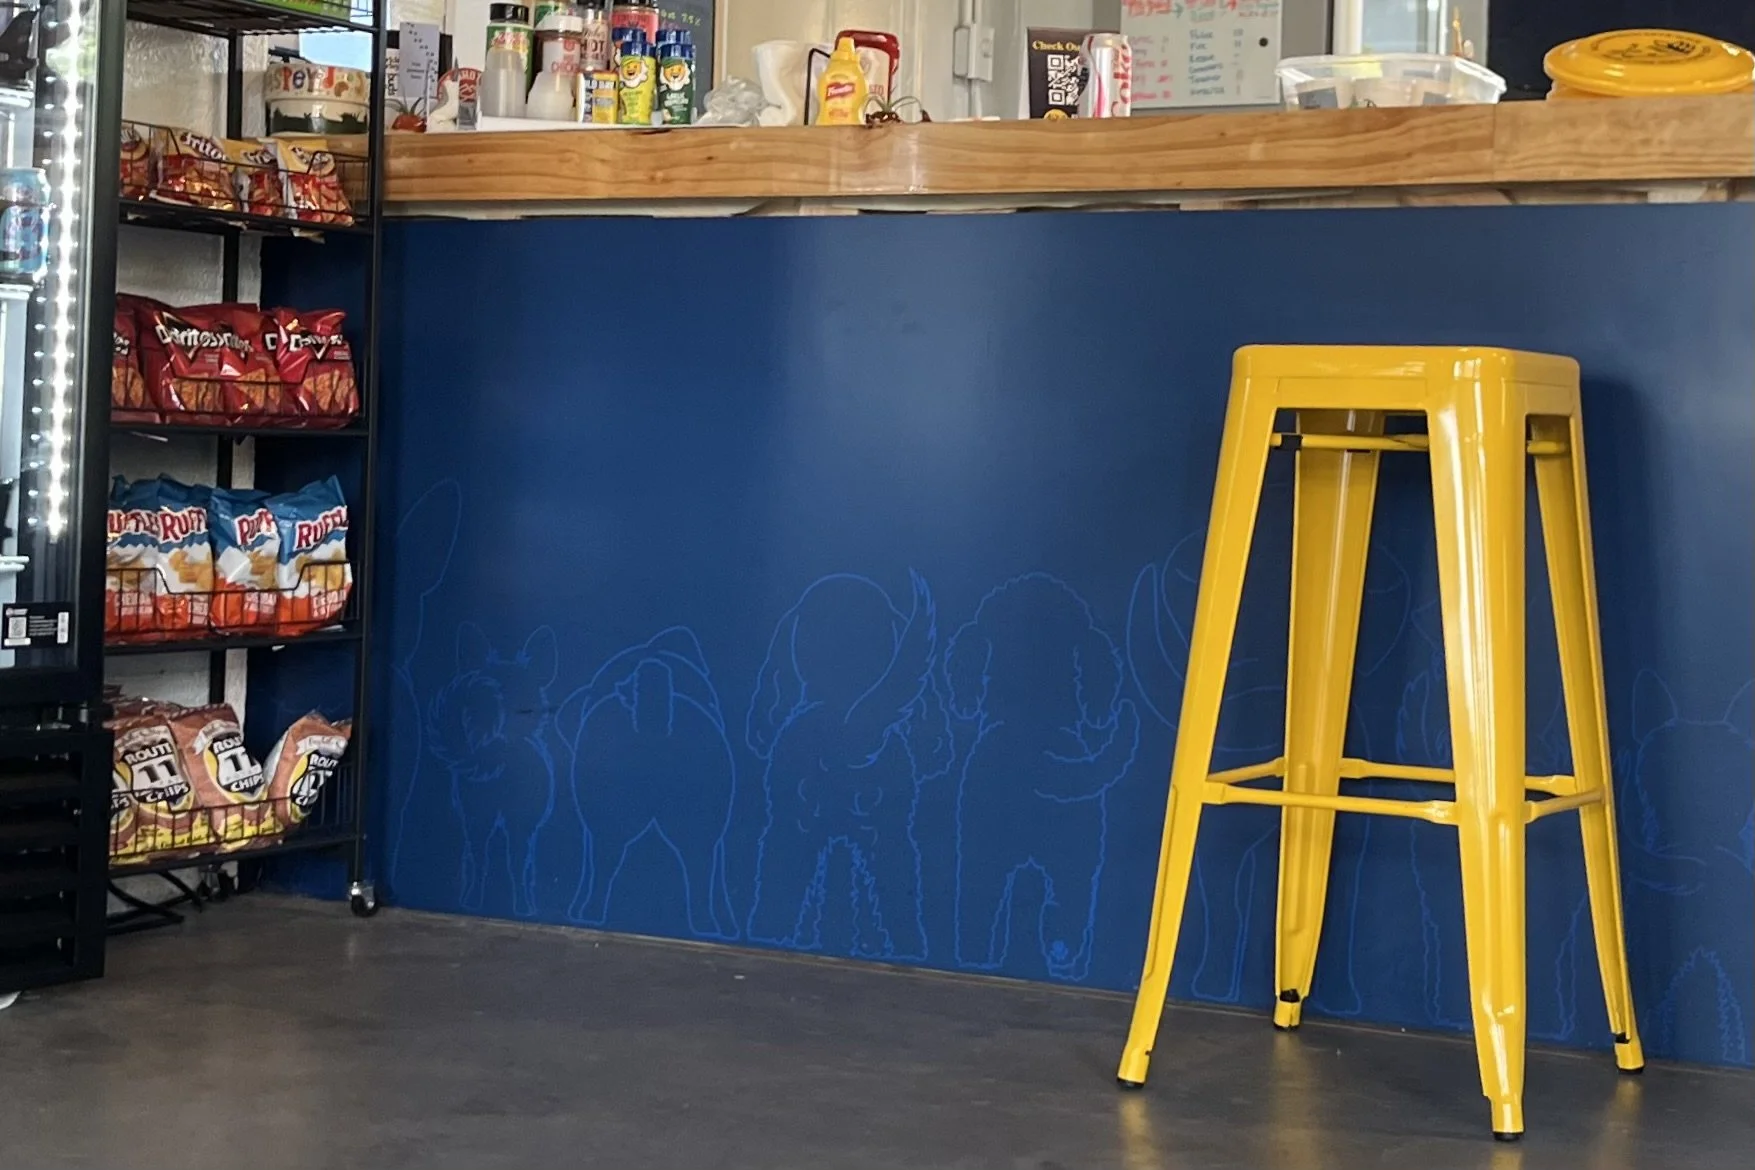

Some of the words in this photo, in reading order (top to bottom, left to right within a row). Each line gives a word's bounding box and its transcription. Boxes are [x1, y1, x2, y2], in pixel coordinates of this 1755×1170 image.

[1032, 40, 1064, 51] Check
[1065, 42, 1081, 51] Ou
[213, 737, 242, 755] ROU
[310, 754, 338, 769] ROUT
[139, 760, 177, 783] 11
